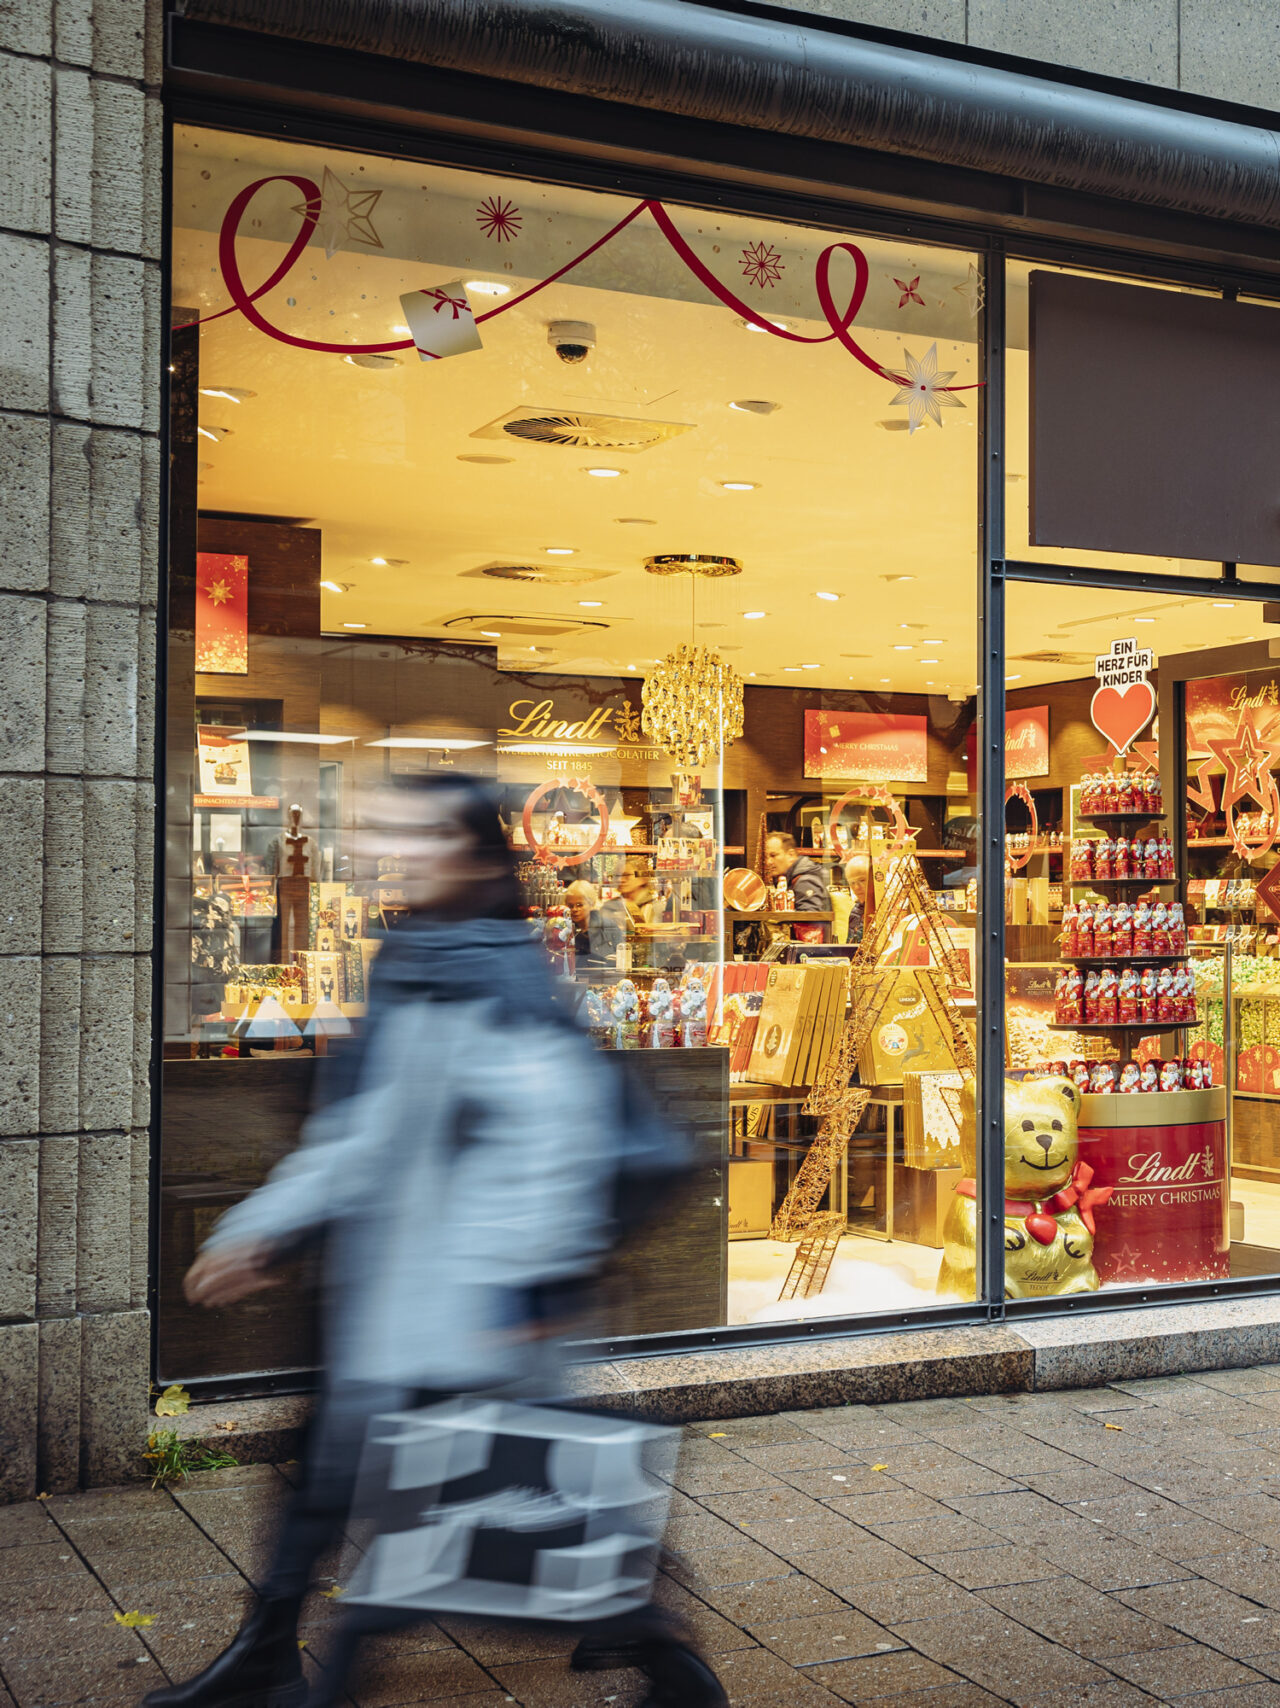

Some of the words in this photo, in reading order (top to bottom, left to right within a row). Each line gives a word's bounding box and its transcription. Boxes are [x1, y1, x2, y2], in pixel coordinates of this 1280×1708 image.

[1114, 642, 1133, 655] EIN
[1097, 658, 1125, 673] HERZ
[1127, 652, 1149, 668] FÜR
[1102, 671, 1143, 687] KINDER
[1226, 685, 1268, 712] Lindt
[497, 699, 614, 740] Lindt
[859, 743, 899, 752] CHRISTMAS
[1005, 725, 1029, 751] indt
[546, 760, 568, 771] SEIT
[571, 761, 593, 772] 1845
[1118, 1151, 1202, 1183] Lindt
[1107, 1193, 1156, 1207] MERRY
[1160, 1187, 1221, 1205] CHRISTMAS
[1021, 1269, 1053, 1281] Lindt
